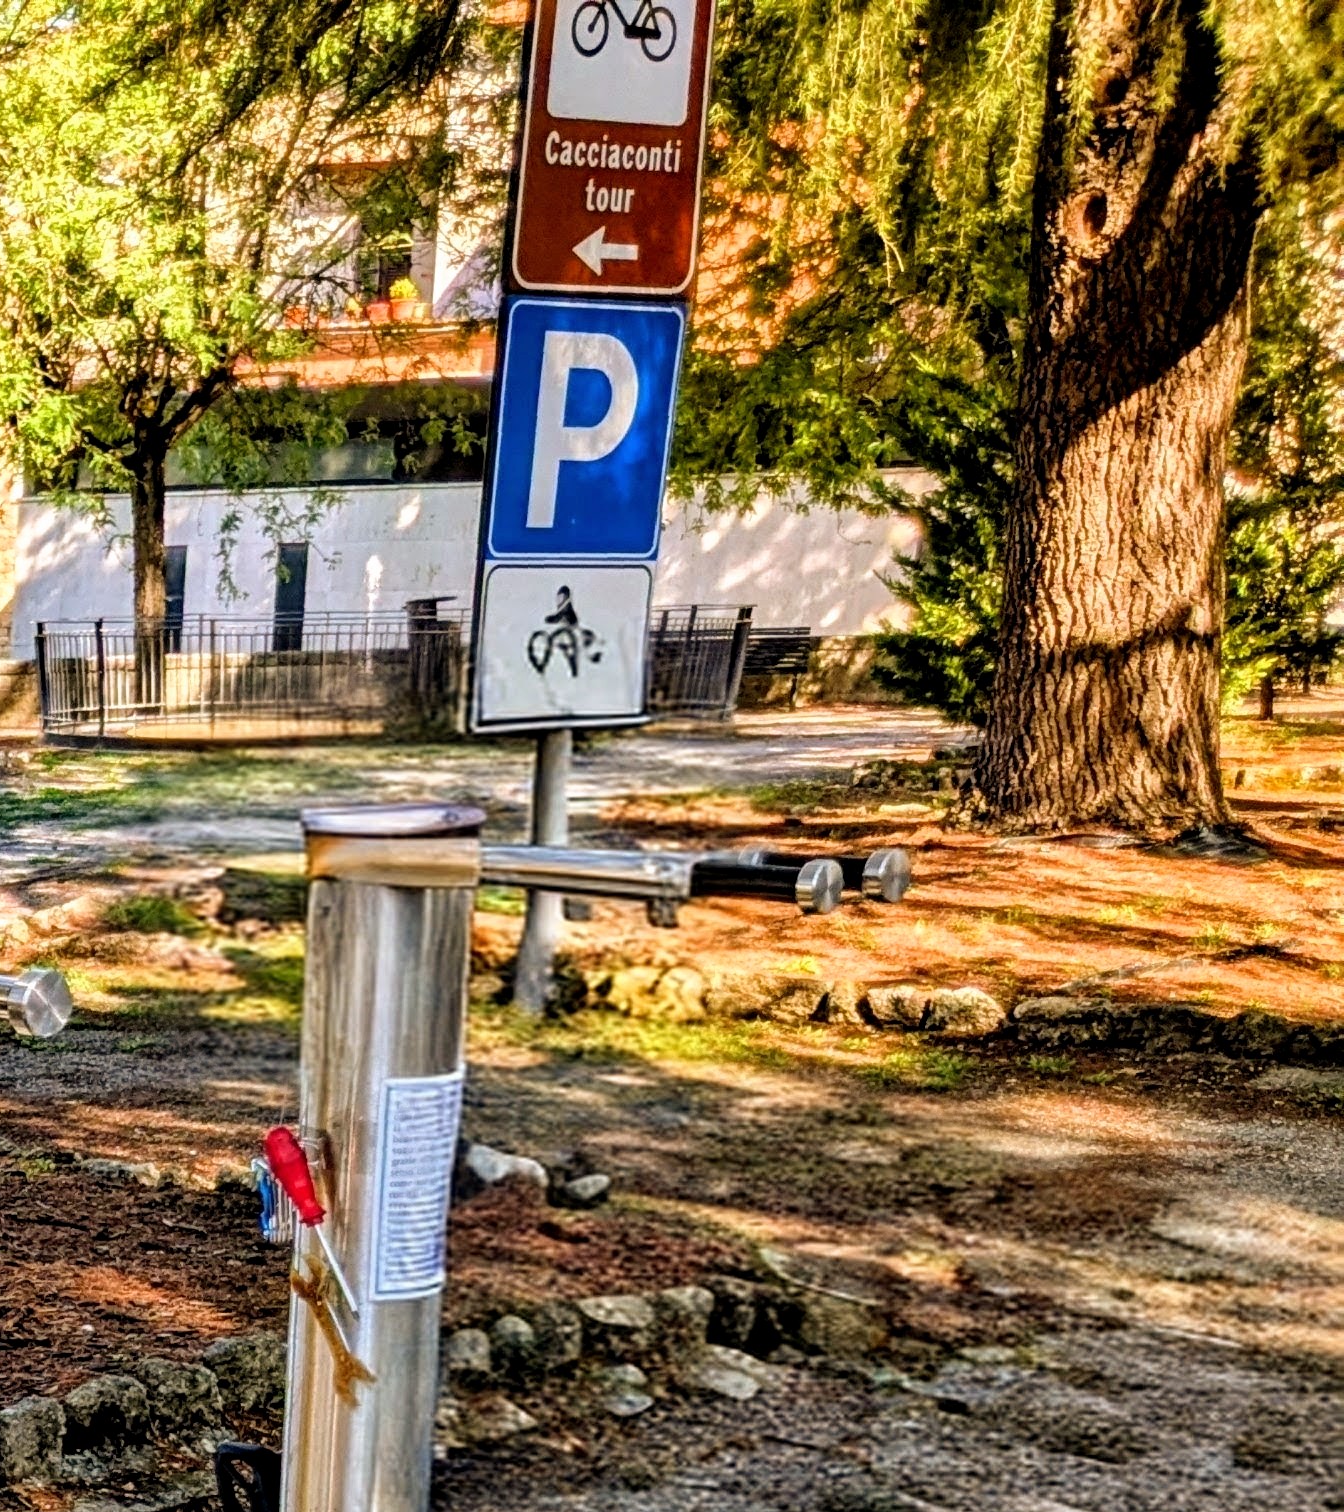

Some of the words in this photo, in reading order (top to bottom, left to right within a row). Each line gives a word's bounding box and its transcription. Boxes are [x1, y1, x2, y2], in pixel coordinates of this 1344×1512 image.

[546, 131, 683, 173] Cacciaconti
[585, 178, 635, 215] tour
[526, 331, 639, 528] P
